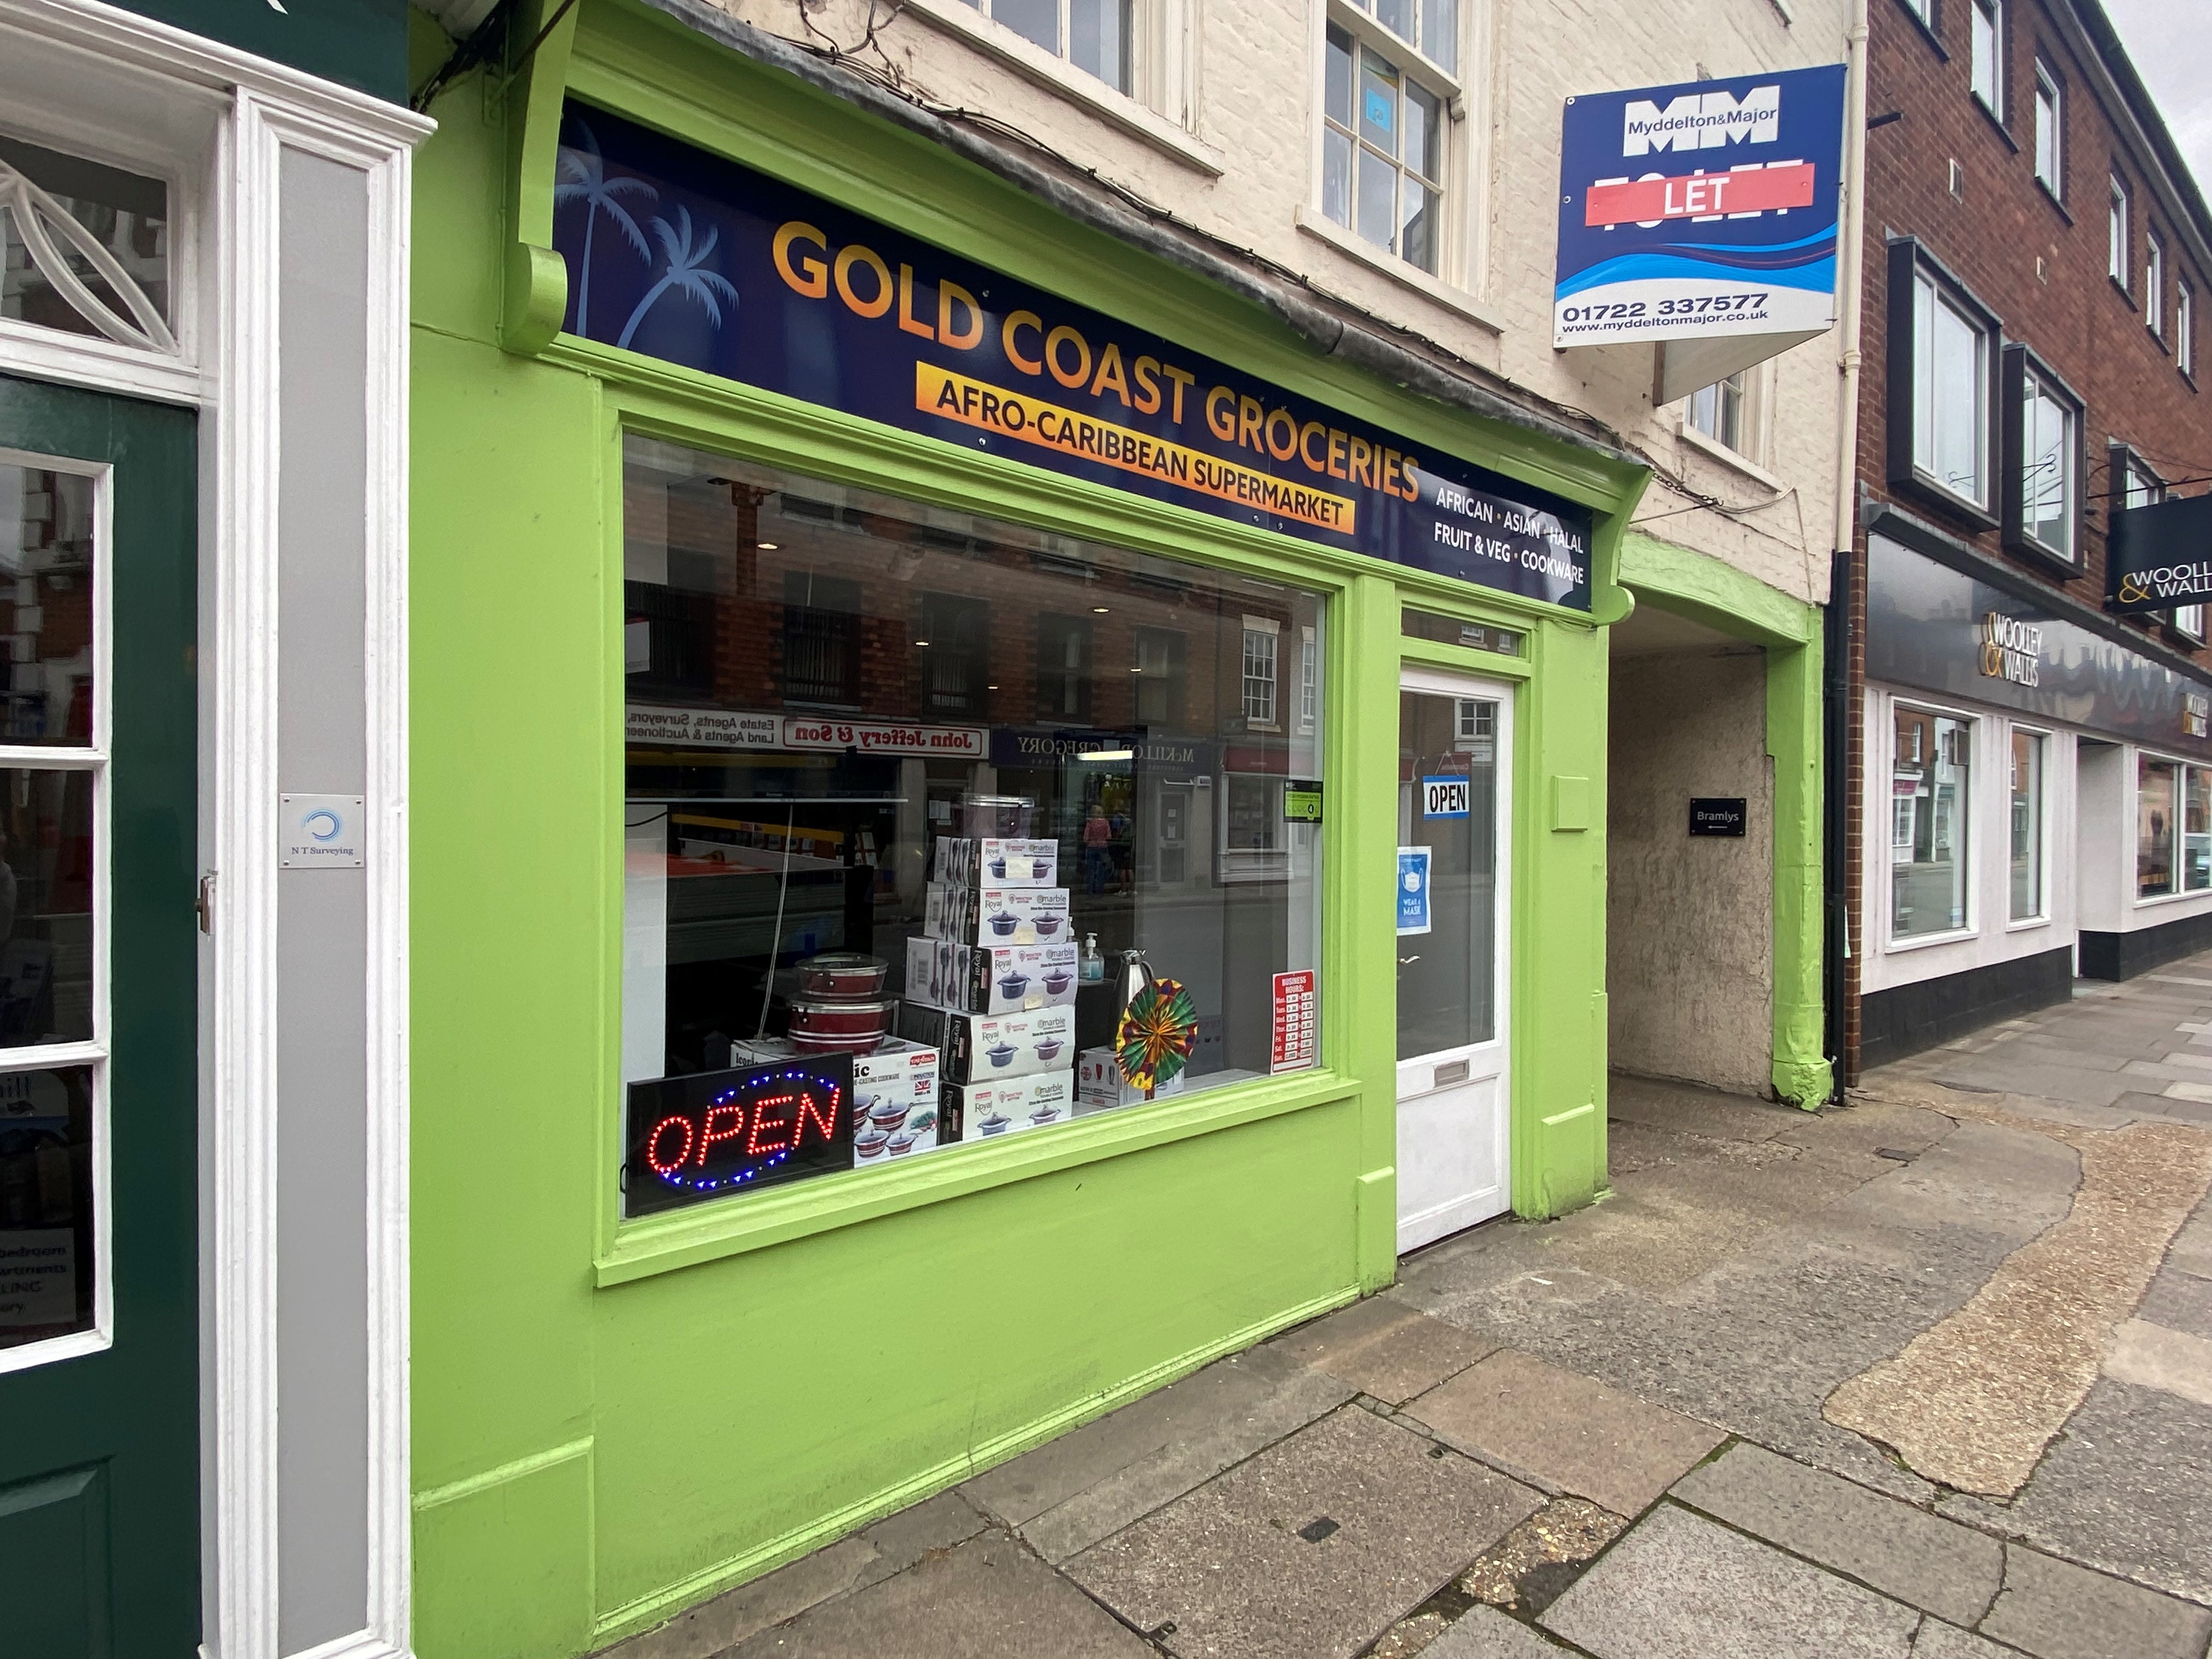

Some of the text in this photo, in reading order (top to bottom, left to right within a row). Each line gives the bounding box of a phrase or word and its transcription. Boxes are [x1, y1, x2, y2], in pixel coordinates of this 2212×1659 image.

[1628, 107, 1777, 137] Myddelton&Major
[1664, 177, 1730, 215] LET
[1562, 293, 1768, 323] 01722 337577
[1562, 311, 1768, 333] www.myddeltonmajor.co.uk
[772, 221, 1419, 503] GOLD COAST GROCERIES
[936, 379, 1344, 526] AFRO-CARIBBEAN SUPERMARKET
[1436, 487, 1584, 554] AFRICAN ASIAN HALAL
[1435, 522, 1584, 584] FRUIT & VEG COOKWARE
[2132, 561, 2212, 586] WOOLL
[2120, 572, 2212, 603] & WALL
[1993, 612, 2042, 656] WOOLLEY
[2004, 650, 2039, 688] WALLIS
[1429, 783, 1466, 814] OPEN
[1697, 810, 1739, 823] Bramlys
[309, 847, 353, 856] Surveying
[985, 899, 1002, 912] Royal
[1042, 894, 1067, 904] marble
[1403, 906, 1421, 916] MASK
[1051, 947, 1075, 958] marble
[995, 959, 1012, 973] Royal
[1042, 1017, 1066, 1027] marble
[982, 1030, 999, 1043] Royal
[854, 1076, 877, 1086] E-CASTING
[1039, 1083, 1063, 1093] marble
[974, 1101, 993, 1116] Royal
[646, 1085, 842, 1174] OPEN
